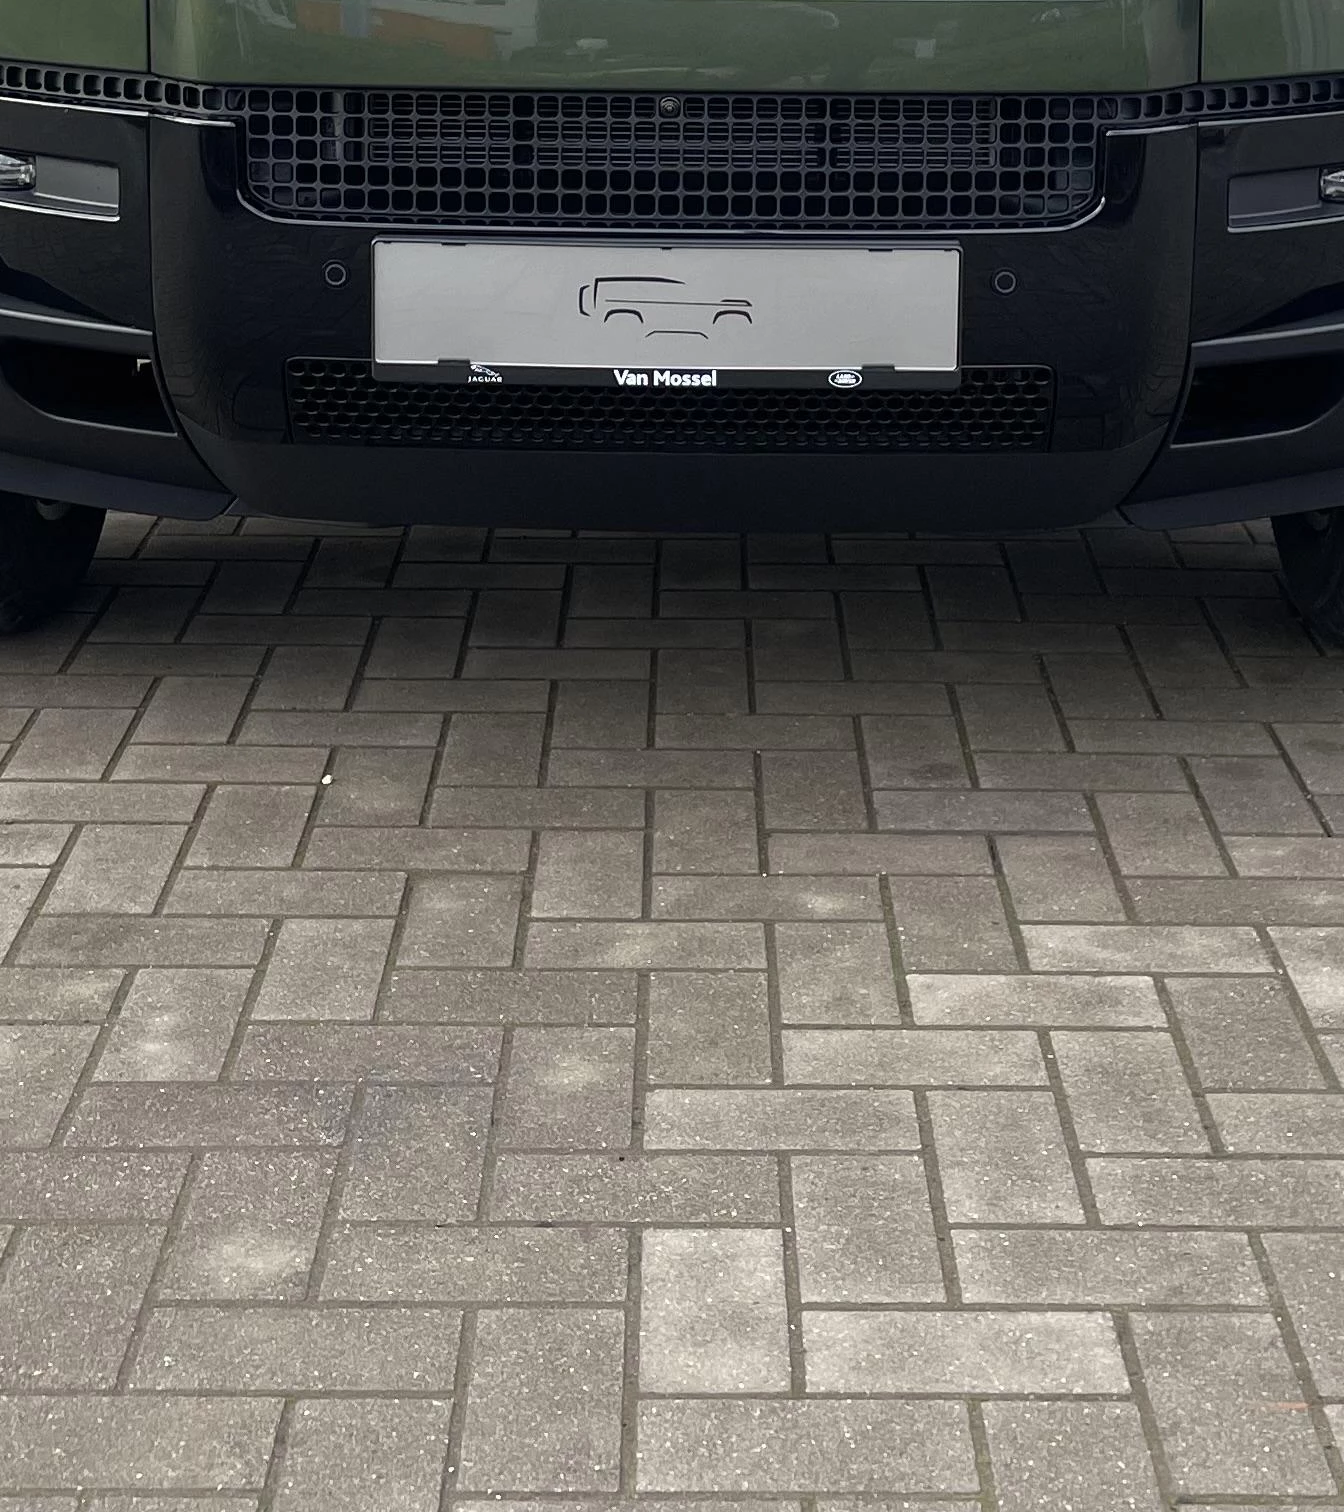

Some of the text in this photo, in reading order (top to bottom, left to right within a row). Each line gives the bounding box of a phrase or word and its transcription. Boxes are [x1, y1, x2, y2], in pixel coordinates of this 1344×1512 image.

[467, 375, 503, 384] JAGUAR
[613, 369, 717, 387] Van Mossel
